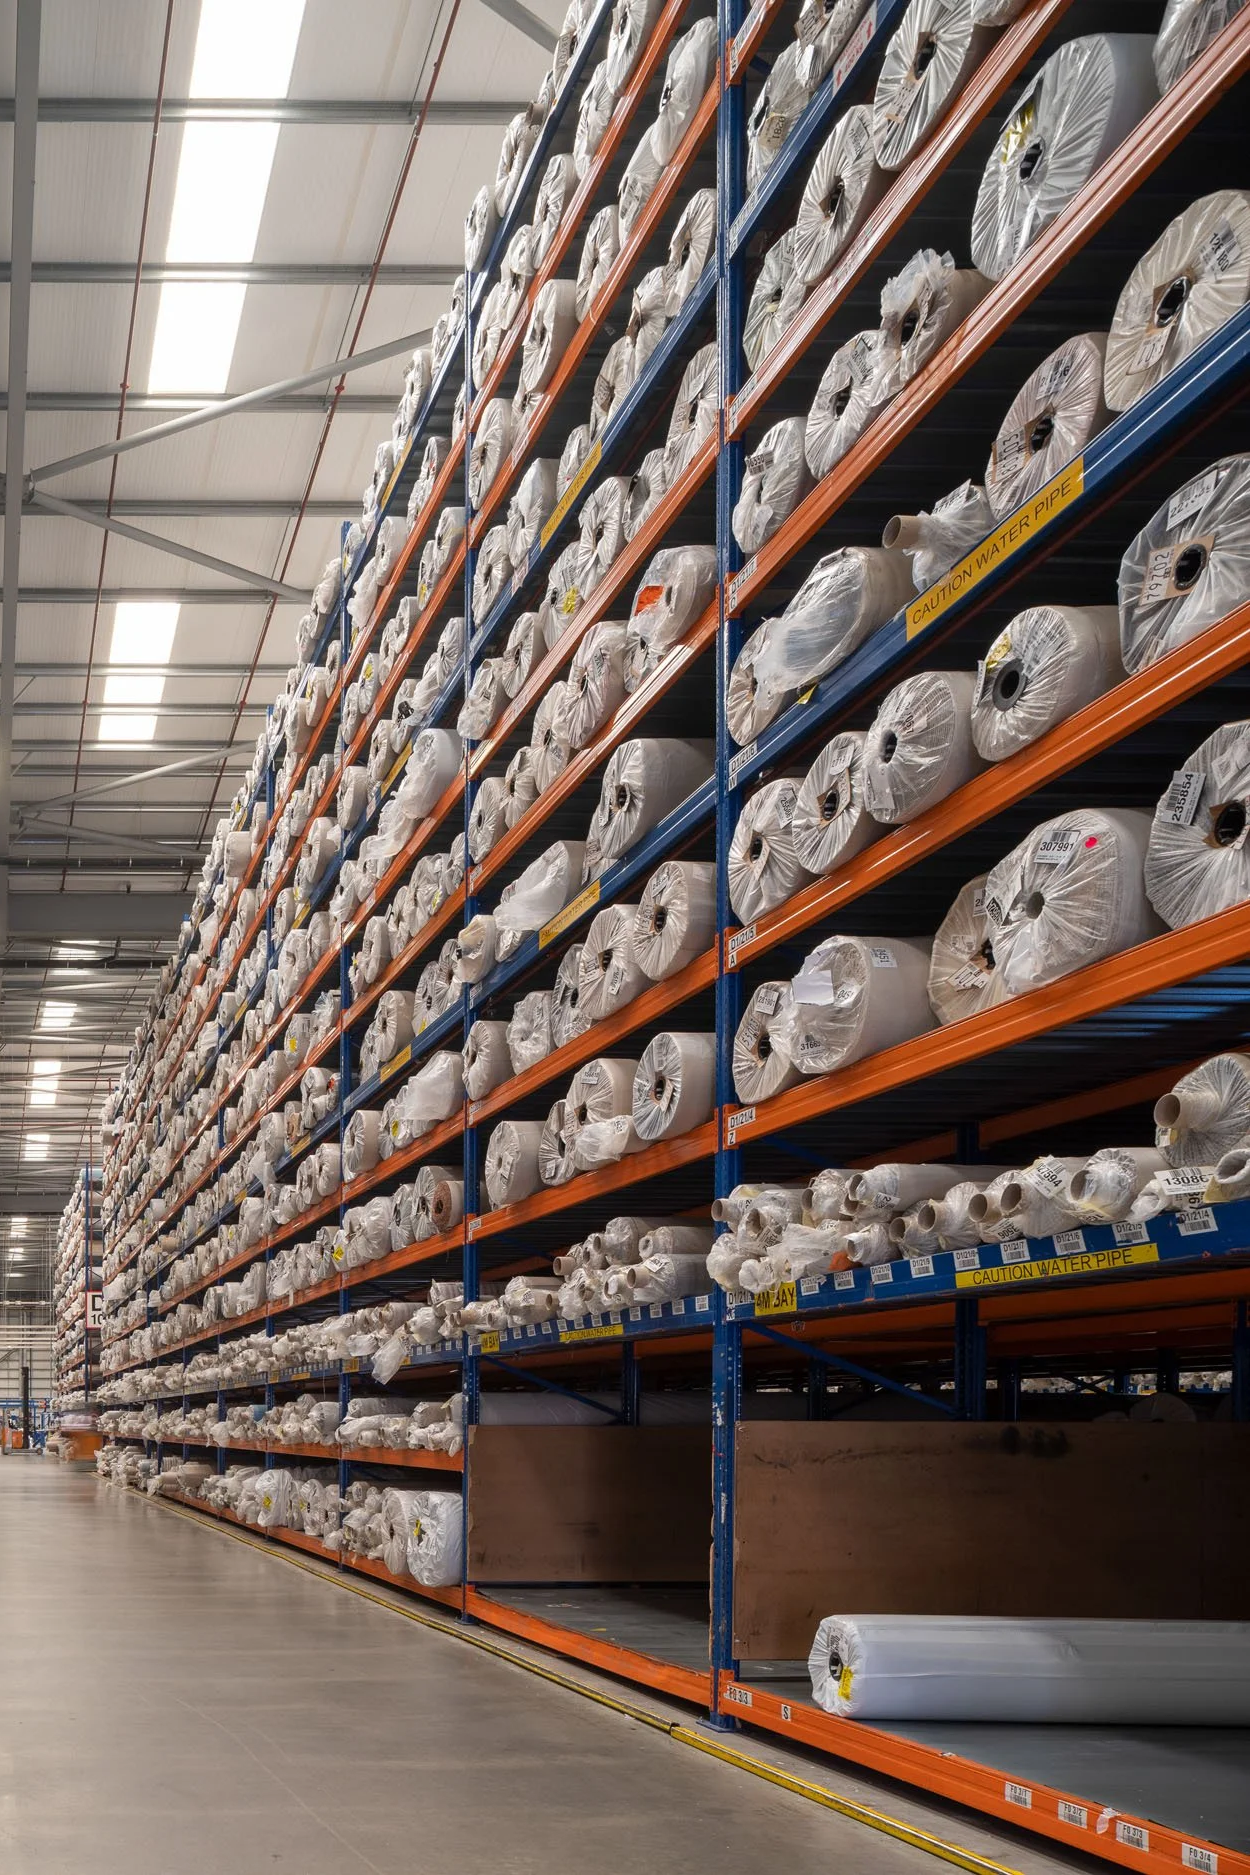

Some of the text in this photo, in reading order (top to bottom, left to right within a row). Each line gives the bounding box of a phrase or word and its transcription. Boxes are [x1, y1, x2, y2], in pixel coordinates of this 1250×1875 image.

[912, 564, 972, 625] CAUTION
[976, 515, 1030, 570] WATER
[1034, 477, 1072, 521] PIPE
[1171, 772, 1194, 822] 235854
[1039, 841, 1074, 852] 307991
[730, 927, 755, 951] D1/21/5
[729, 955, 736, 967] A
[729, 1110, 754, 1128] D1/21/4
[728, 1132, 735, 1145] Z
[1055, 1232, 1081, 1243] D1/21/6
[1003, 1241, 1025, 1252] D1/21/7
[972, 1247, 1134, 1285] CAUTION WATER PIPE
[783, 1706, 789, 1720] S
[1072, 1806, 1083, 1817] 3/2
[1132, 1826, 1143, 1839] 3/3
[1199, 1850, 1212, 1863] 3/4
